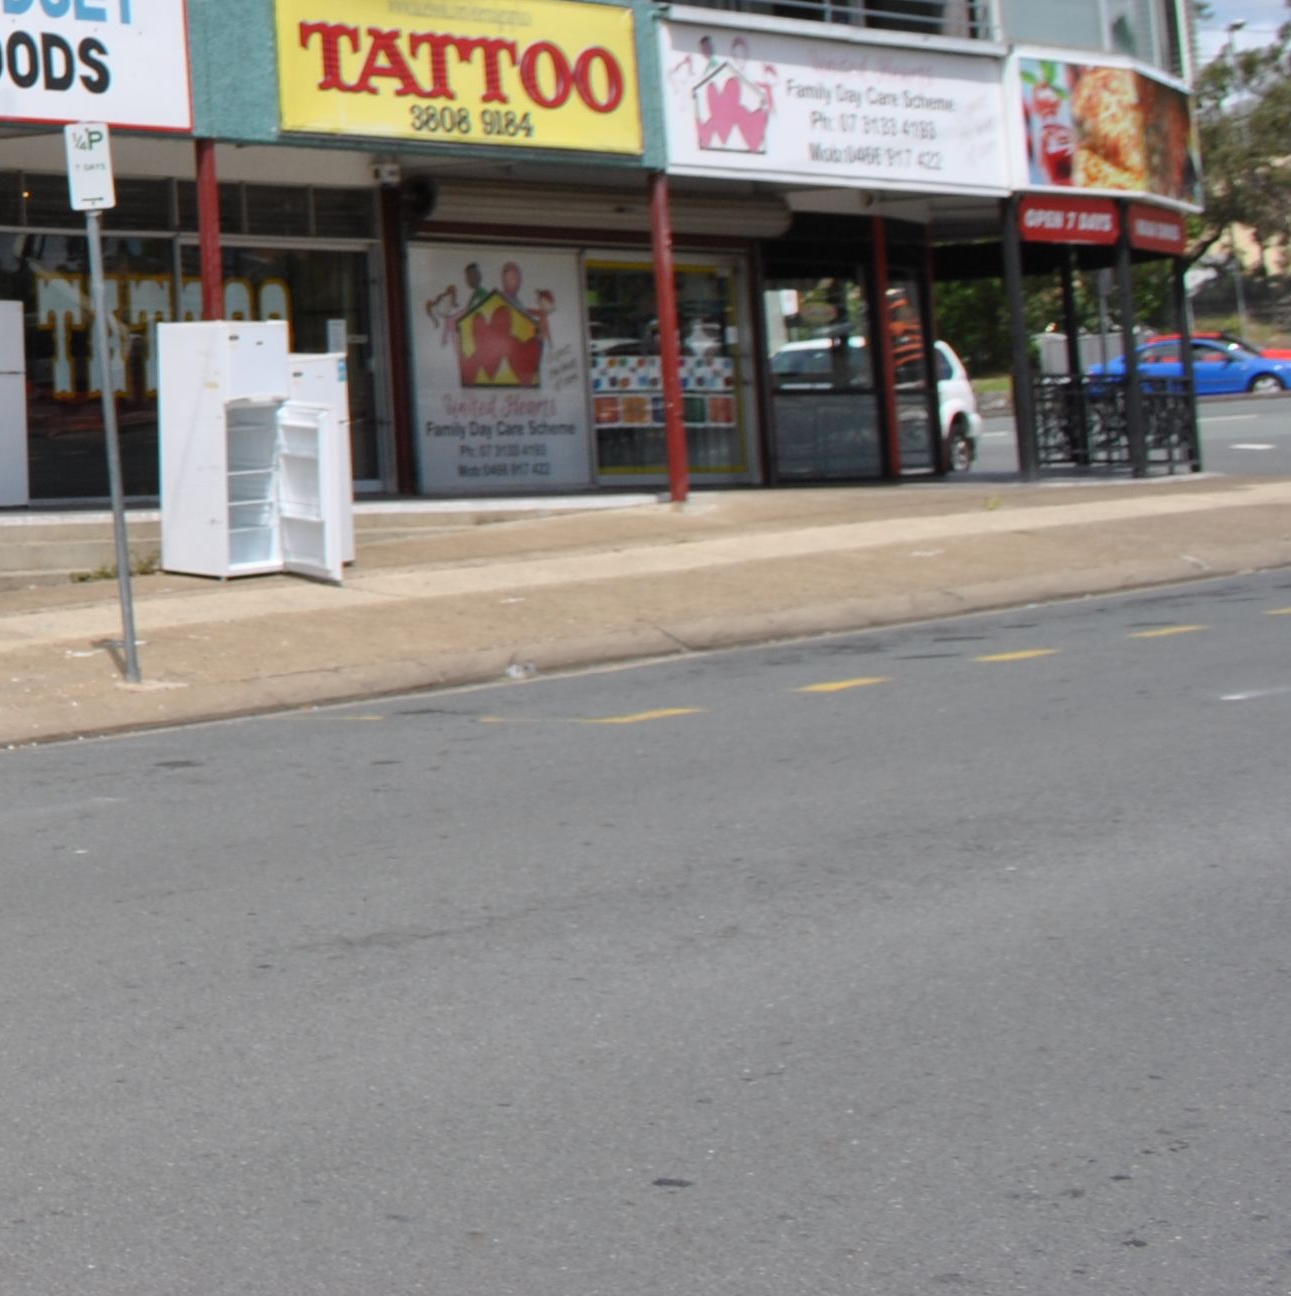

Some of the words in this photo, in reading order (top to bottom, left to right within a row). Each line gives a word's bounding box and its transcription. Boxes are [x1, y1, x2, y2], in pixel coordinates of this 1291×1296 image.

[299, 20, 625, 113] TATTOO
[786, 79, 831, 105] Family
[836, 84, 861, 108] Day
[867, 86, 898, 105] Care
[903, 90, 956, 112] Scheme
[410, 104, 471, 134] 3808
[481, 109, 534, 138] 9184
[1024, 208, 1064, 229] OPEN
[1066, 211, 1077, 230] 7
[426, 421, 466, 439] Family
[470, 421, 492, 439] Day
[496, 421, 524, 436] Care
[528, 420, 576, 435] Scheme
